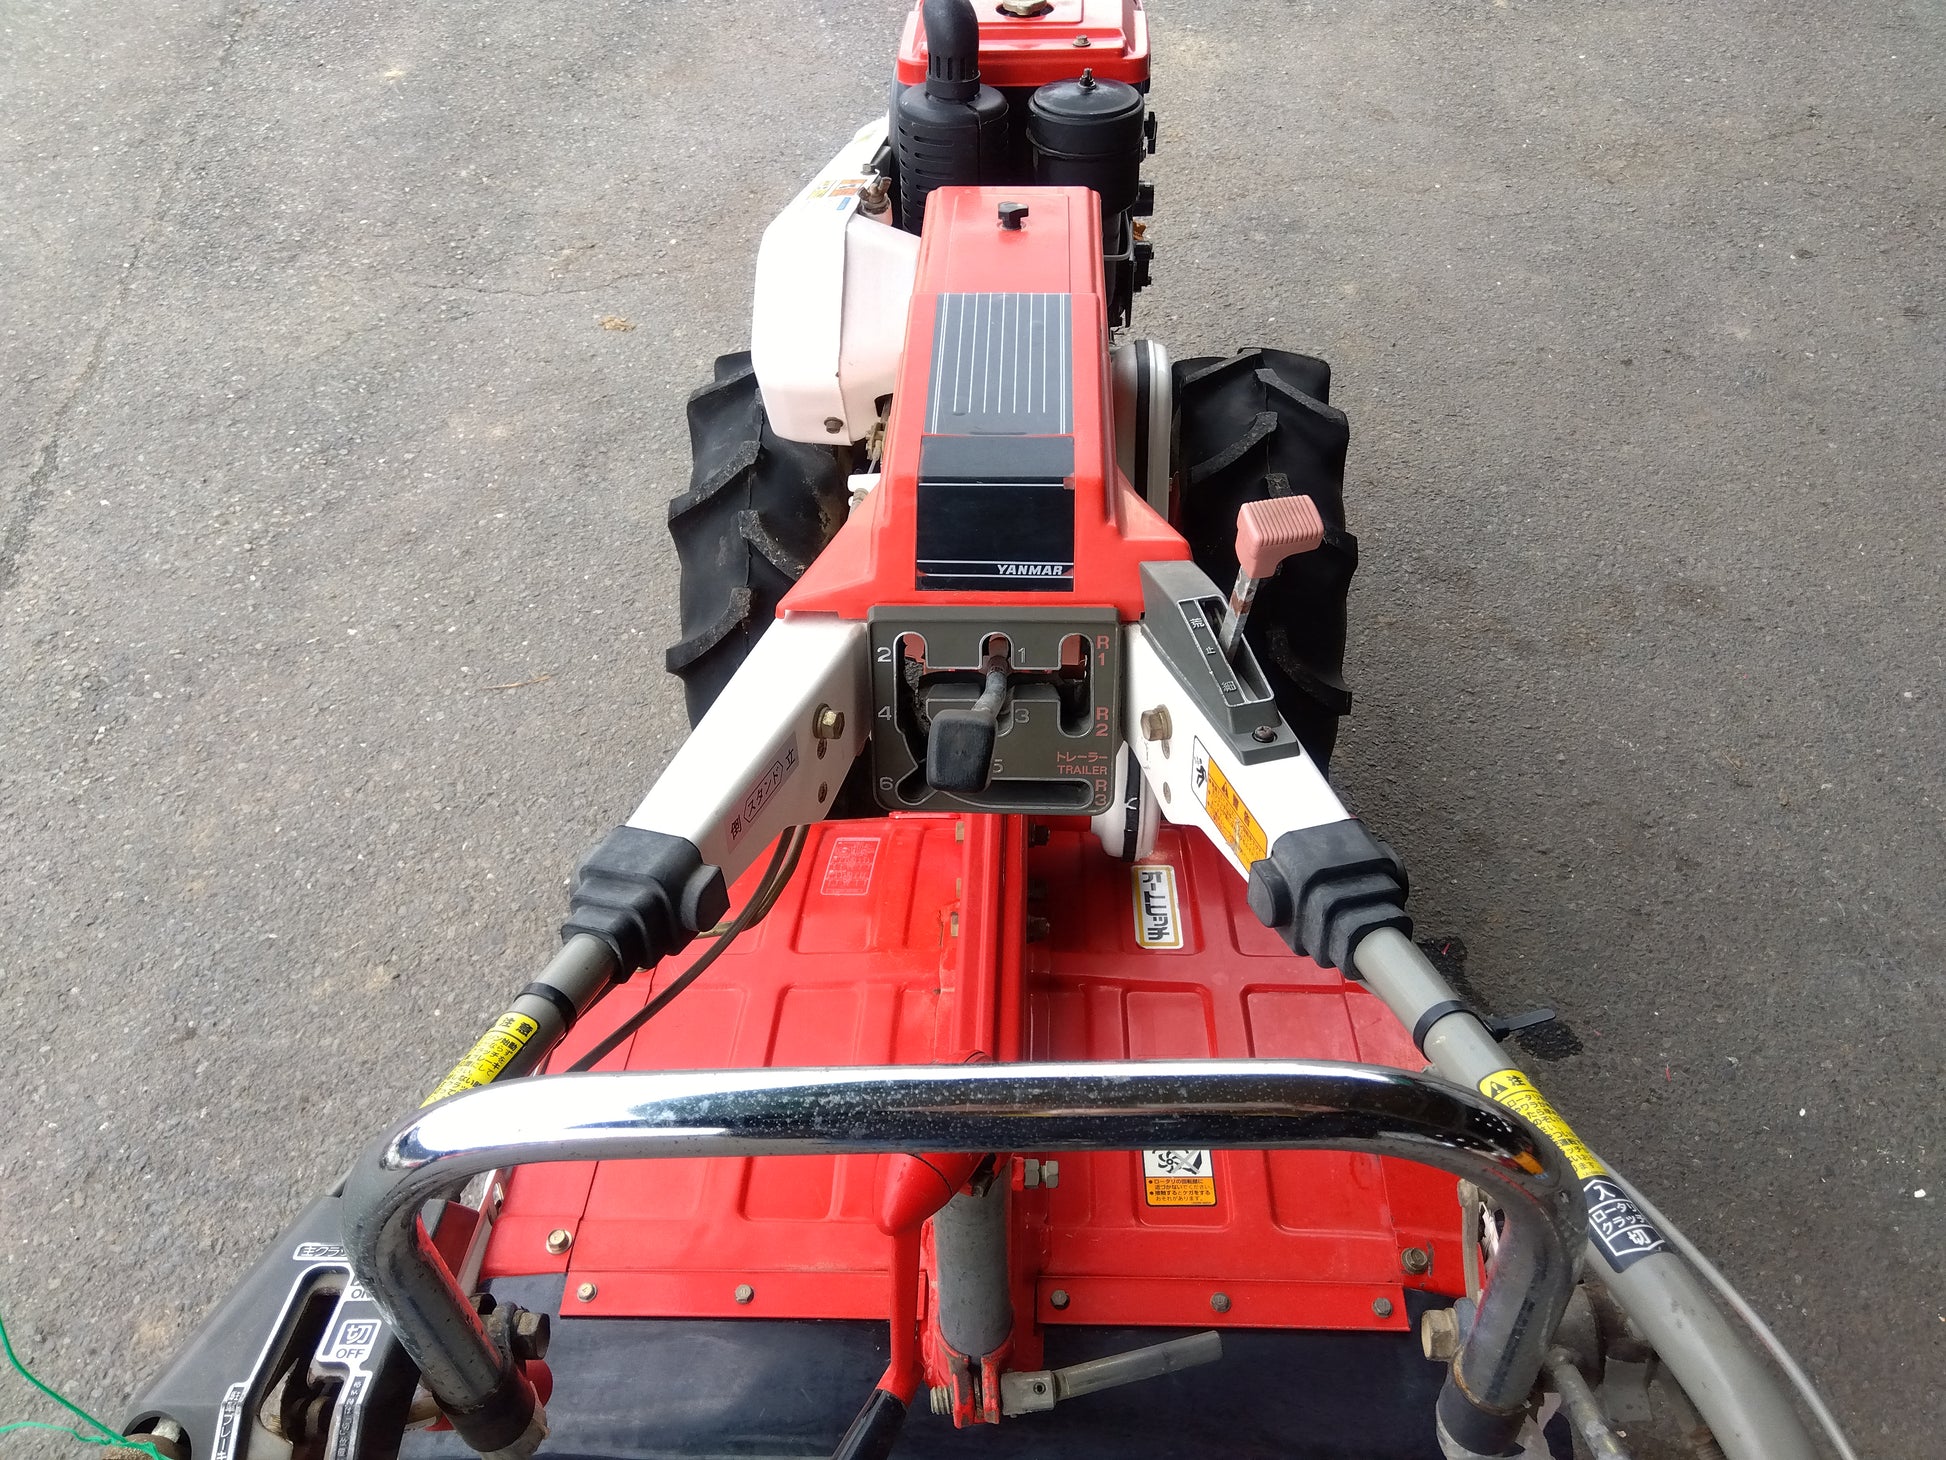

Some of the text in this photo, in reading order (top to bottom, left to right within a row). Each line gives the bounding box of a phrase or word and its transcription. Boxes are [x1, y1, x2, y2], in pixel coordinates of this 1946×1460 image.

[997, 564, 1063, 575] YANMAR
[877, 647, 892, 662] 2
[1017, 647, 1027, 663] 1
[877, 705, 892, 721] 4
[1015, 708, 1030, 723] 3
[1056, 751, 1108, 763] トレーラー
[992, 759, 1004, 774] 5
[1057, 765, 1108, 775] TRAILER
[747, 766, 779, 817] スタンド
[785, 748, 796, 771] 立
[879, 777, 893, 790] 6
[1593, 1185, 1615, 1201] 入
[1592, 1202, 1637, 1223] ロータリ
[1602, 1214, 1645, 1234] クラッチ
[1627, 1229, 1651, 1246] 切
[346, 1324, 373, 1345] 切
[336, 1348, 366, 1359] OFF
